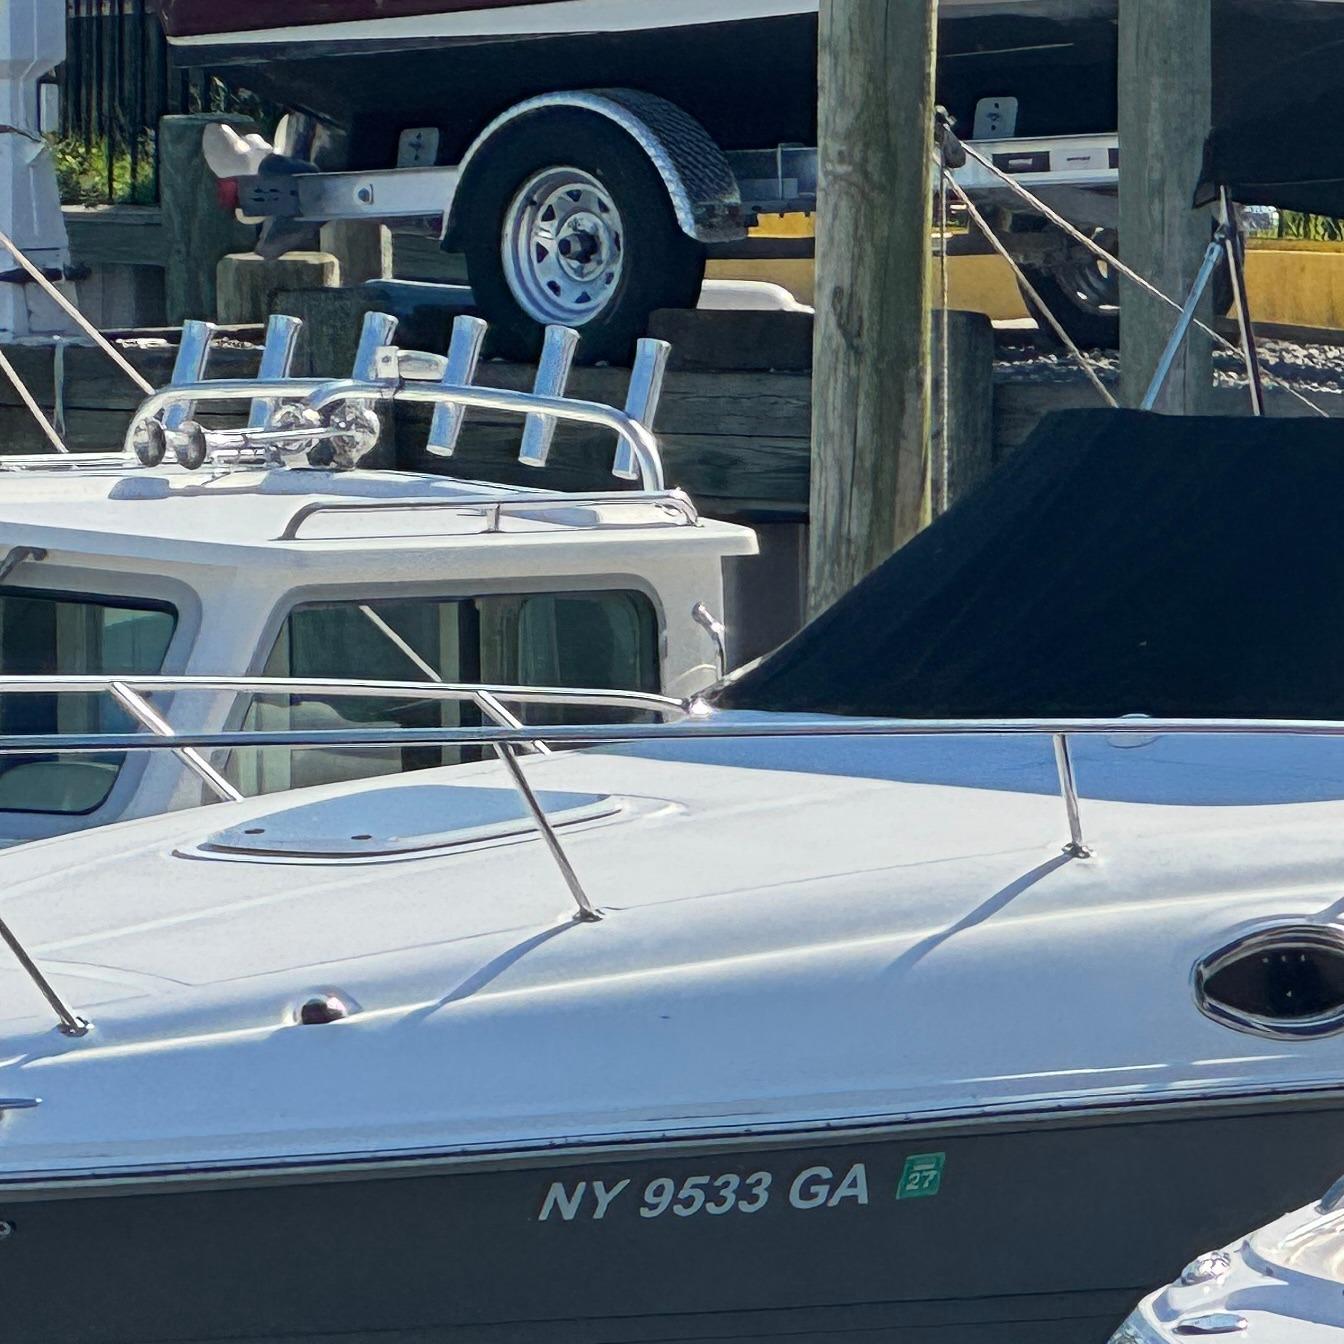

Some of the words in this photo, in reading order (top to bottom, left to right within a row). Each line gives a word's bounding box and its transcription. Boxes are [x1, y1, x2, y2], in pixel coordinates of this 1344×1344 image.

[538, 1179, 630, 1221] NY
[640, 1172, 772, 1217] 9533
[789, 1163, 870, 1209] GA
[905, 1170, 938, 1190] 27
